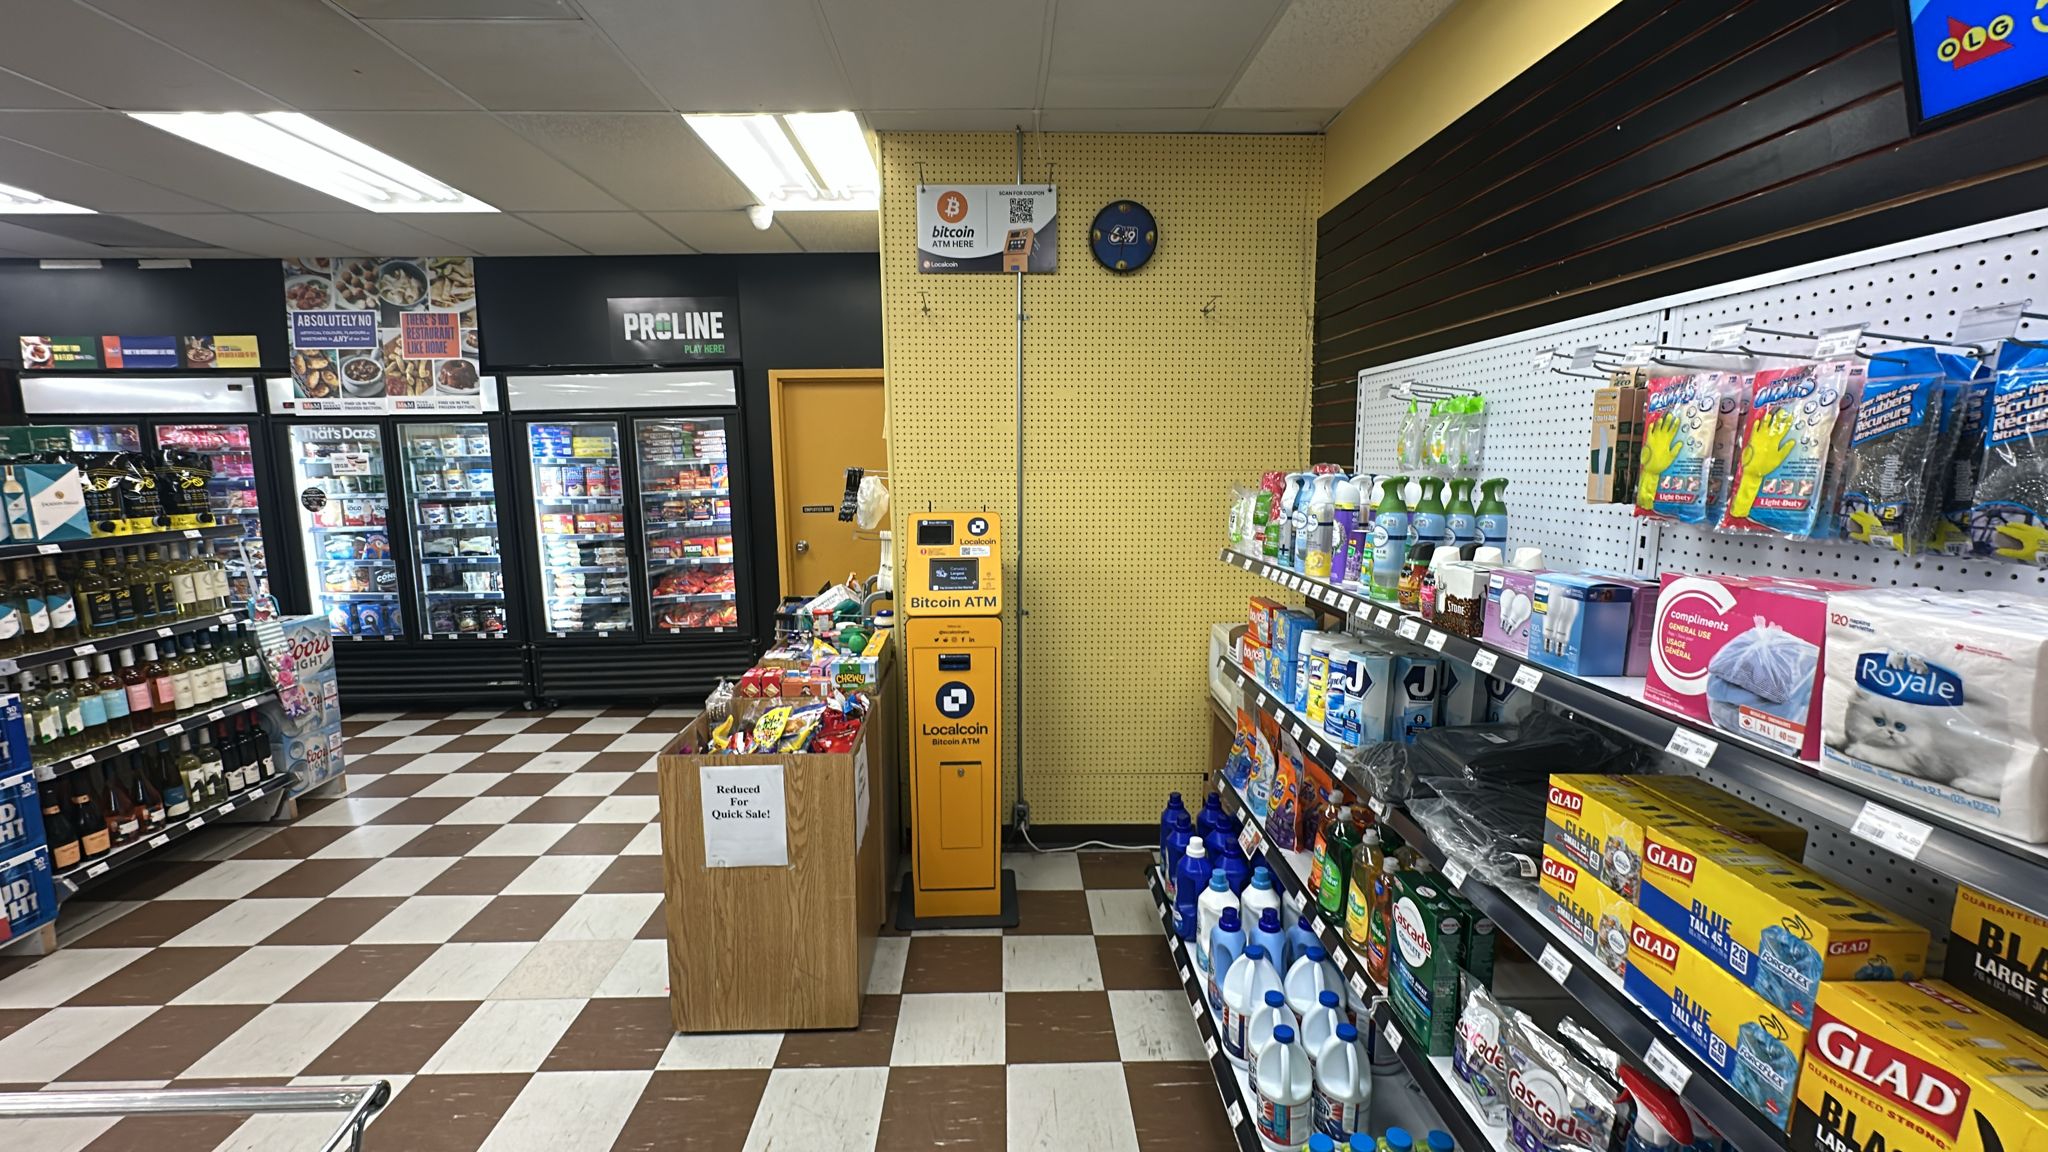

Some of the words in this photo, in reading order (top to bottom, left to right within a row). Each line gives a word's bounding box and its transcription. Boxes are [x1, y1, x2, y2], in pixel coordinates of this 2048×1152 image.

[1940, 19, 2010, 58] OLG
[932, 226, 974, 238] bitcoin
[952, 240, 974, 248] HERE
[298, 314, 357, 327] ABSOLUTELY
[359, 314, 372, 326] NO
[407, 313, 436, 325] THERE'S
[438, 313, 449, 325] NO
[624, 312, 724, 340] PROLINE
[406, 327, 454, 340] RESTAURANT
[408, 341, 424, 354] LIKE
[426, 341, 448, 354] HOME
[684, 344, 702, 354] PLAY
[704, 344, 725, 353] HERE!
[1858, 392, 1912, 419] Scrubbers
[342, 427, 376, 439] Dazs
[911, 597, 960, 608] Bitcoin
[965, 596, 997, 607] ATM
[1671, 610, 1729, 631] compliments
[1830, 613, 1848, 626] 120
[1669, 622, 1697, 636] GENERAL
[1698, 630, 1712, 640] USE
[1243, 647, 1262, 660] bounce
[1664, 645, 1692, 661] GÉNÉRAL
[1666, 637, 1686, 649] USAGE
[1862, 658, 1955, 699] Royale
[923, 722, 988, 736] Localcoin
[716, 785, 760, 794] Reduced
[1549, 787, 1582, 810] GLAD
[730, 797, 748, 806] For
[712, 809, 743, 819] Quick
[746, 810, 770, 819] Sale!
[1566, 819, 1600, 853] CLEAR
[1647, 843, 1692, 874] GLAD
[1543, 858, 1576, 884] GLAD
[1559, 892, 1594, 928] CLEAR
[1691, 898, 1732, 936] BLUE
[1392, 902, 1431, 954] Cascade
[1690, 914, 1709, 939] TALL
[1711, 931, 1723, 947] 45
[1632, 927, 1676, 961] GLAD
[1732, 945, 1746, 963] 26
[1829, 940, 1868, 955] GLAD
[1762, 951, 1811, 992] FORCEFLEX
[1975, 952, 2038, 997] LARGE
[1673, 985, 1712, 1024] BLUE
[1672, 1001, 1690, 1030] TALL
[1692, 1021, 1703, 1037] 45
[1711, 1037, 1724, 1055] 26
[1738, 1046, 1785, 1088] FORCEFLEX
[1817, 1022, 1958, 1116] GLAD
[1507, 1068, 1594, 1146] Cascade
[1808, 1063, 1883, 1112] GUARANTEED
[1887, 1109, 1949, 1150] STRONG
